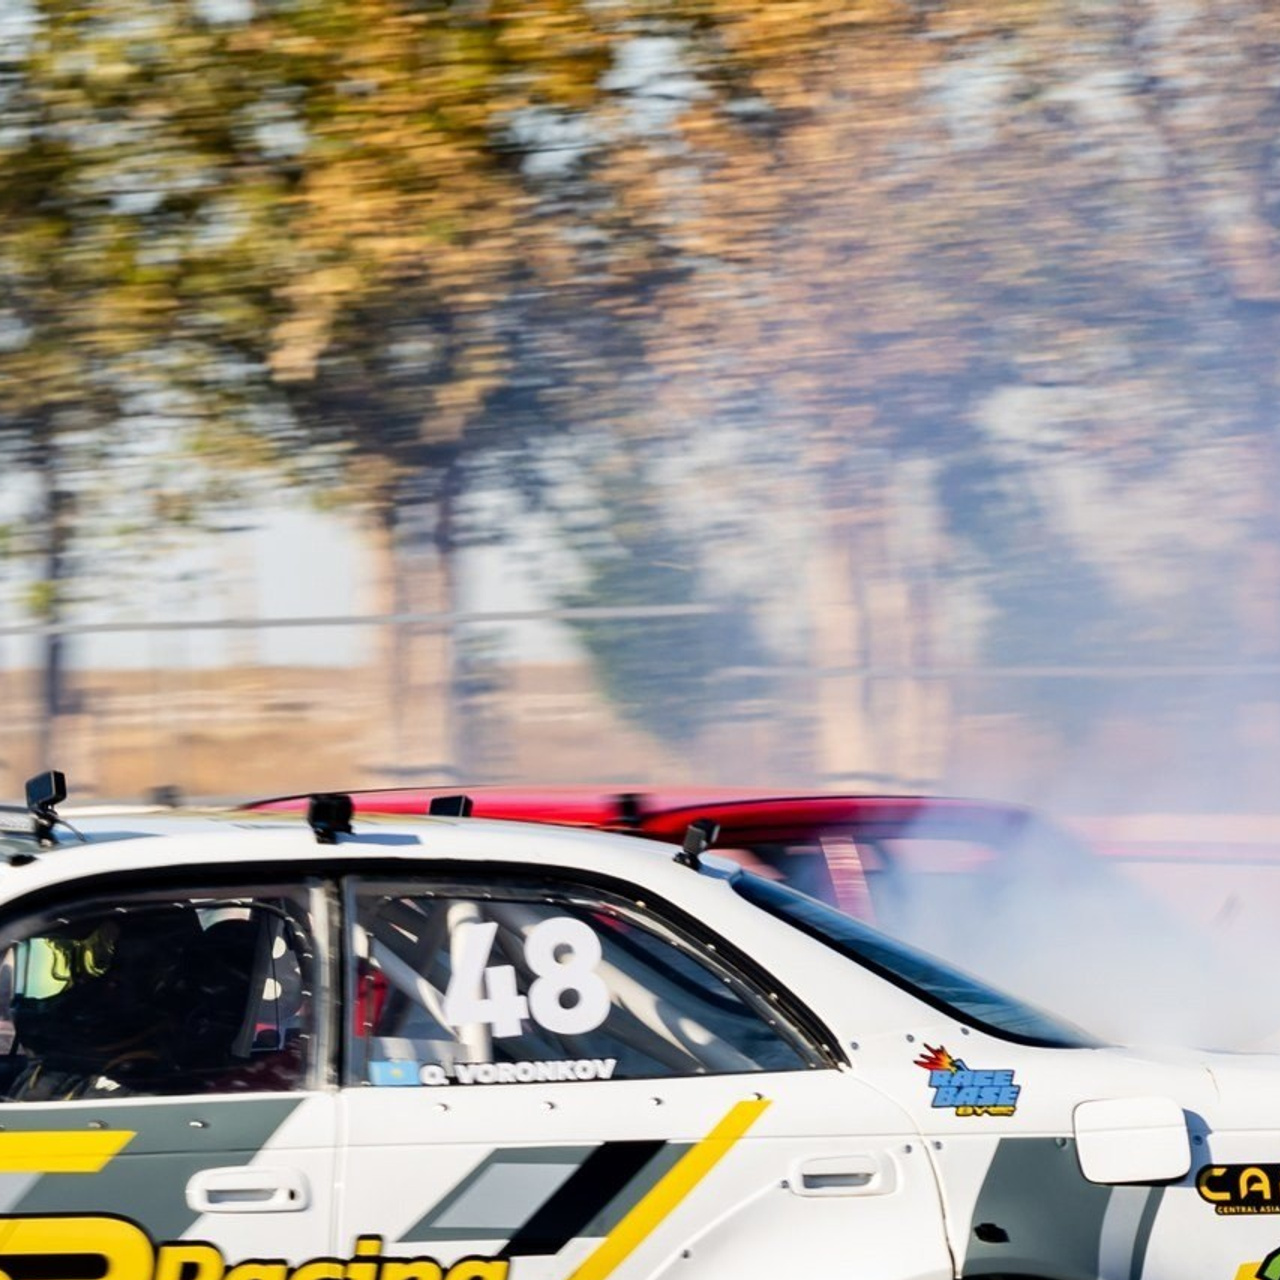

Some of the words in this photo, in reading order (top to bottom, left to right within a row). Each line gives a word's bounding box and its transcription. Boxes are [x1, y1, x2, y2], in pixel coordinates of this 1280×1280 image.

[445, 916, 611, 1038] 48
[454, 1058, 618, 1084] VORONKOV
[1200, 1166, 1280, 1201] CA
[1217, 1205, 1258, 1213] CENTRAL
